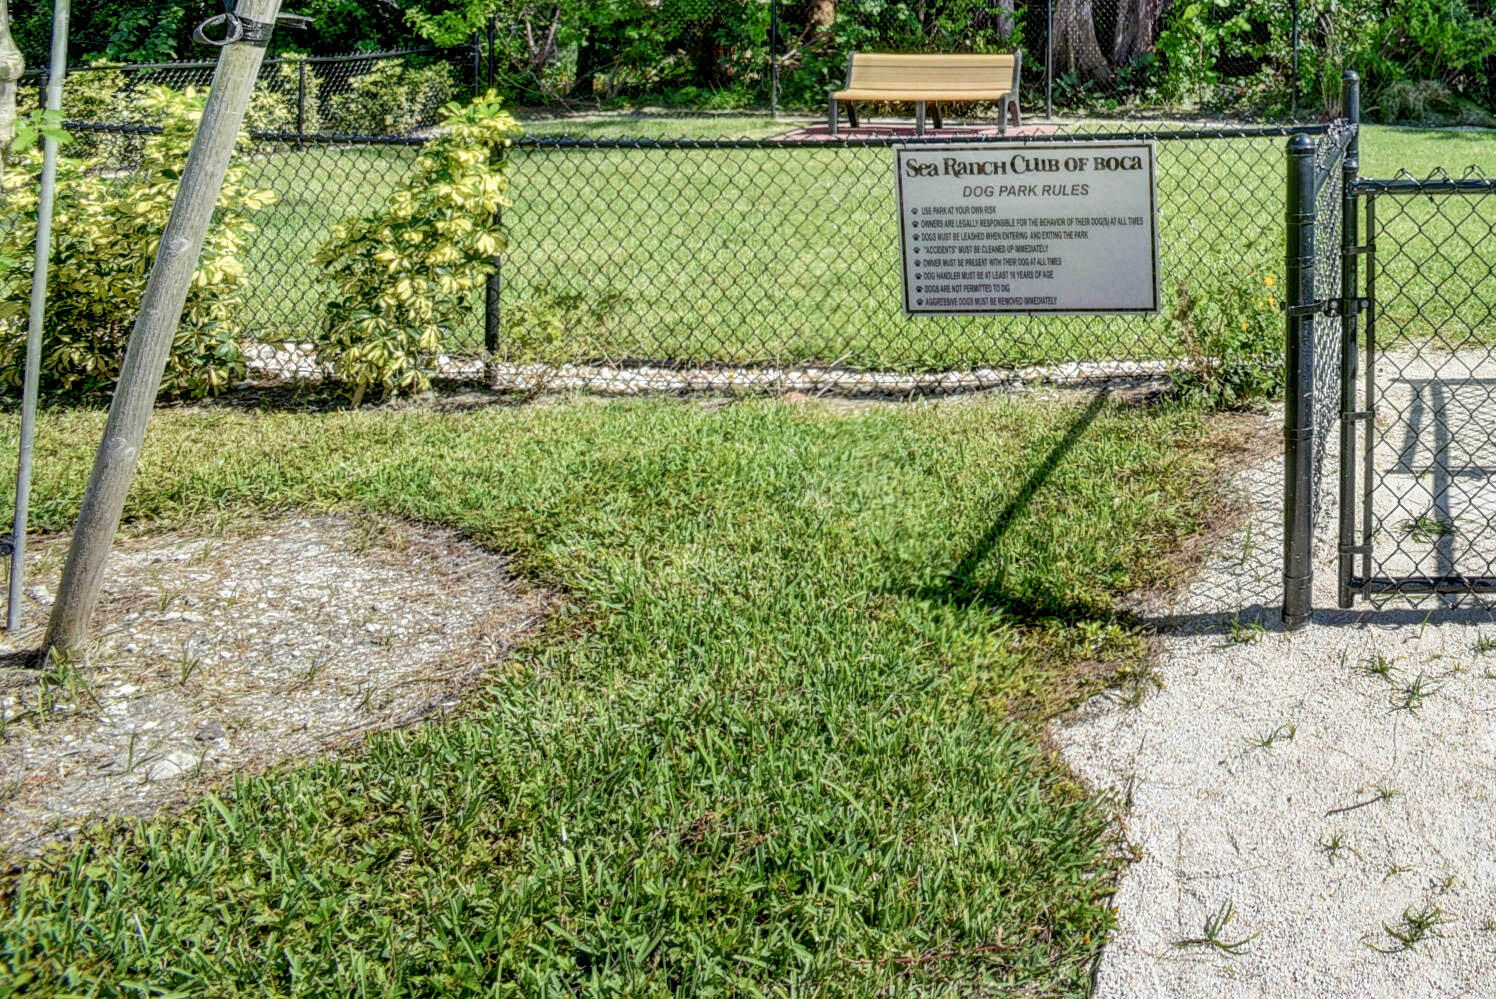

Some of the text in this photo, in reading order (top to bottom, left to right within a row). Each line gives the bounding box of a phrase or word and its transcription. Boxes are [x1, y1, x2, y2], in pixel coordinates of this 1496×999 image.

[906, 158, 939, 177] Sea
[1064, 157, 1089, 172] OF
[963, 184, 1089, 197] DOG PARK RULES
[921, 206, 997, 215] USE PARK AT YOUR OWN RISK
[921, 220, 943, 228] OWNERS
[956, 219, 979, 227] LEGALLY
[1017, 218, 1027, 227] FOR
[1028, 218, 1039, 226] THE
[1040, 218, 1065, 226] BEHAVIOR
[1075, 217, 1090, 225] THEIR
[1110, 217, 1117, 225] AT
[1117, 217, 1128, 225] ALL
[1128, 217, 1143, 225] TIMES
[921, 231, 1088, 241] DOGS MUST BE LEASHED WHEN ENTERING AND EXITING THE PARK
[959, 245, 973, 254] MUST
[974, 245, 981, 253] BE
[982, 245, 1006, 253] CLEANED
[1007, 245, 1014, 253] UP
[923, 259, 941, 267] OWNER
[943, 259, 957, 267] MUST
[958, 259, 964, 267] BE
[965, 258, 988, 267] PRESENT
[989, 258, 1002, 266] WITH
[1003, 258, 1017, 266] THEIR
[1018, 258, 1030, 266] DOG
[924, 272, 935, 280] DOG
[936, 272, 961, 280] HANDLER
[962, 272, 976, 280] MUST
[977, 272, 984, 280] BE
[985, 272, 991, 280] AT
[993, 271, 1009, 279] LEAST
[1017, 271, 1034, 279] YEARS
[1035, 271, 1043, 279] OF
[1043, 270, 1053, 279] AGE
[925, 284, 1010, 293] DOGS ARE NOT PERMITTED TO DIG
[926, 297, 958, 306] AGGRESSIVE
[959, 297, 974, 306] DOGS
[975, 297, 989, 305] MUST
[990, 297, 997, 305] BE
[998, 297, 1023, 305] REMOVED
